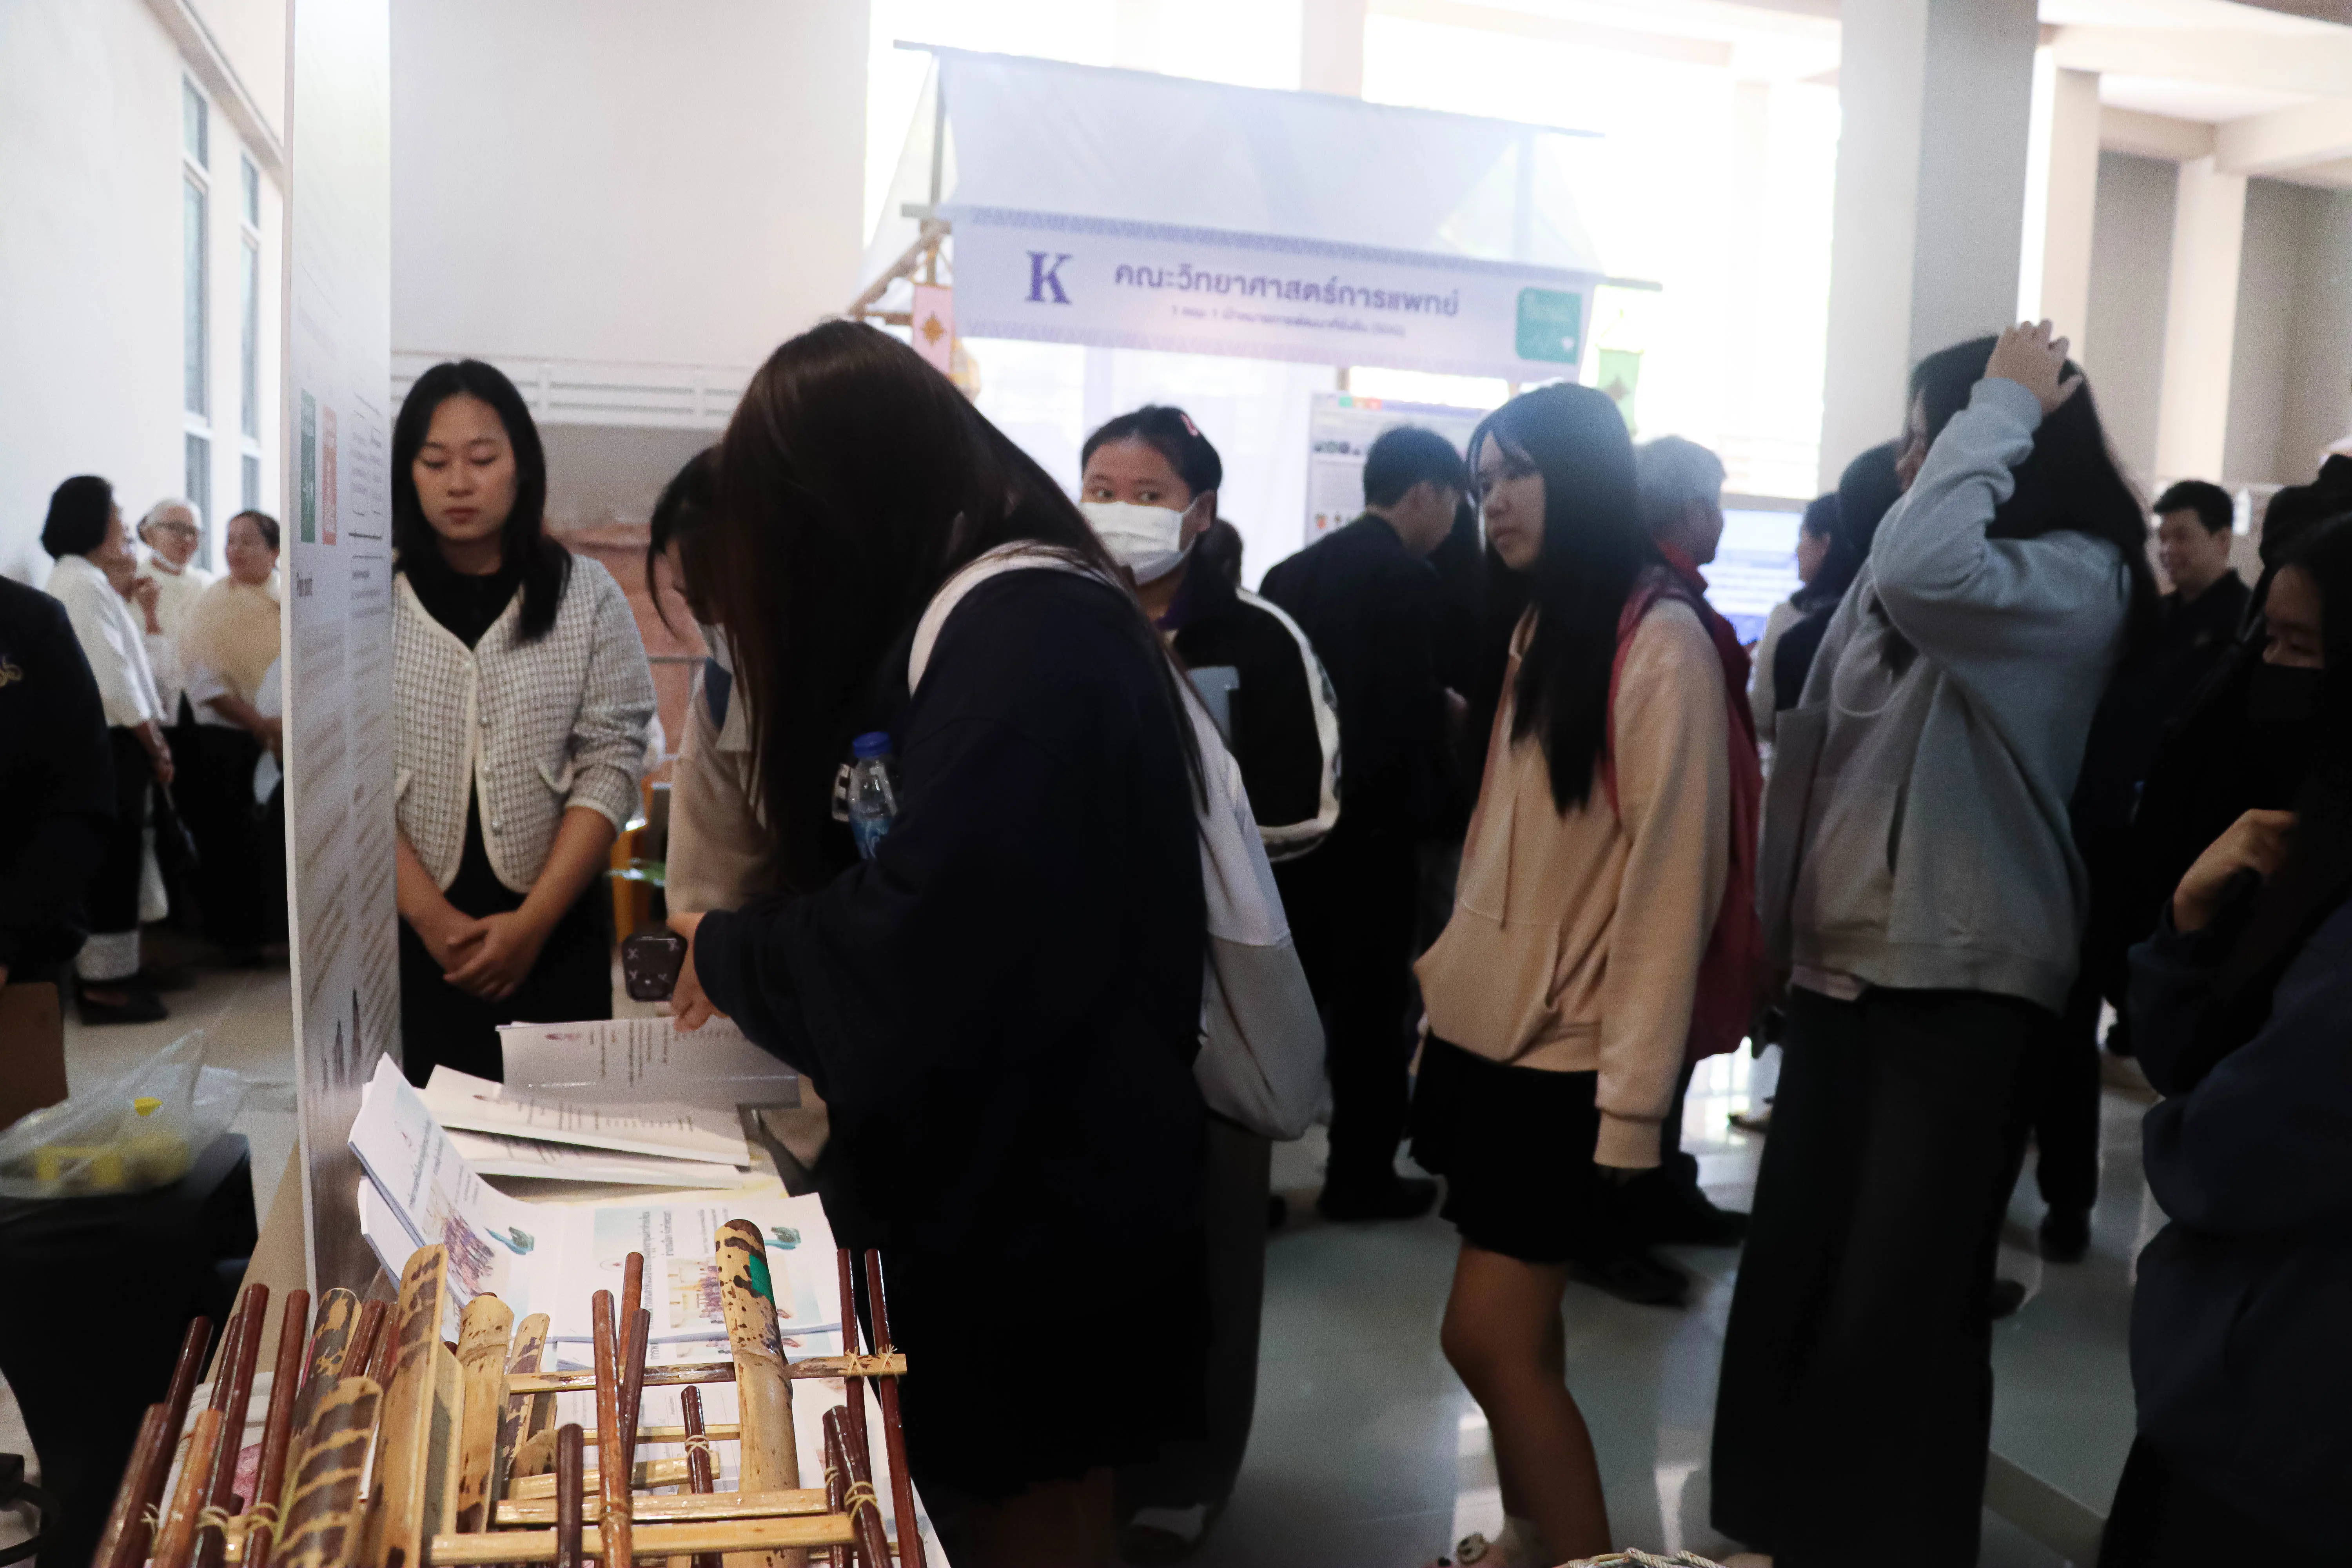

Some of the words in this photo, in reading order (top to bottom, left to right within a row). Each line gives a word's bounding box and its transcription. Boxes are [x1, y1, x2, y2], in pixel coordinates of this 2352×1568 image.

[1026, 250, 1073, 304] K
[1115, 263, 1459, 316] คณะวิทยาศาสตร์การแพทย์
